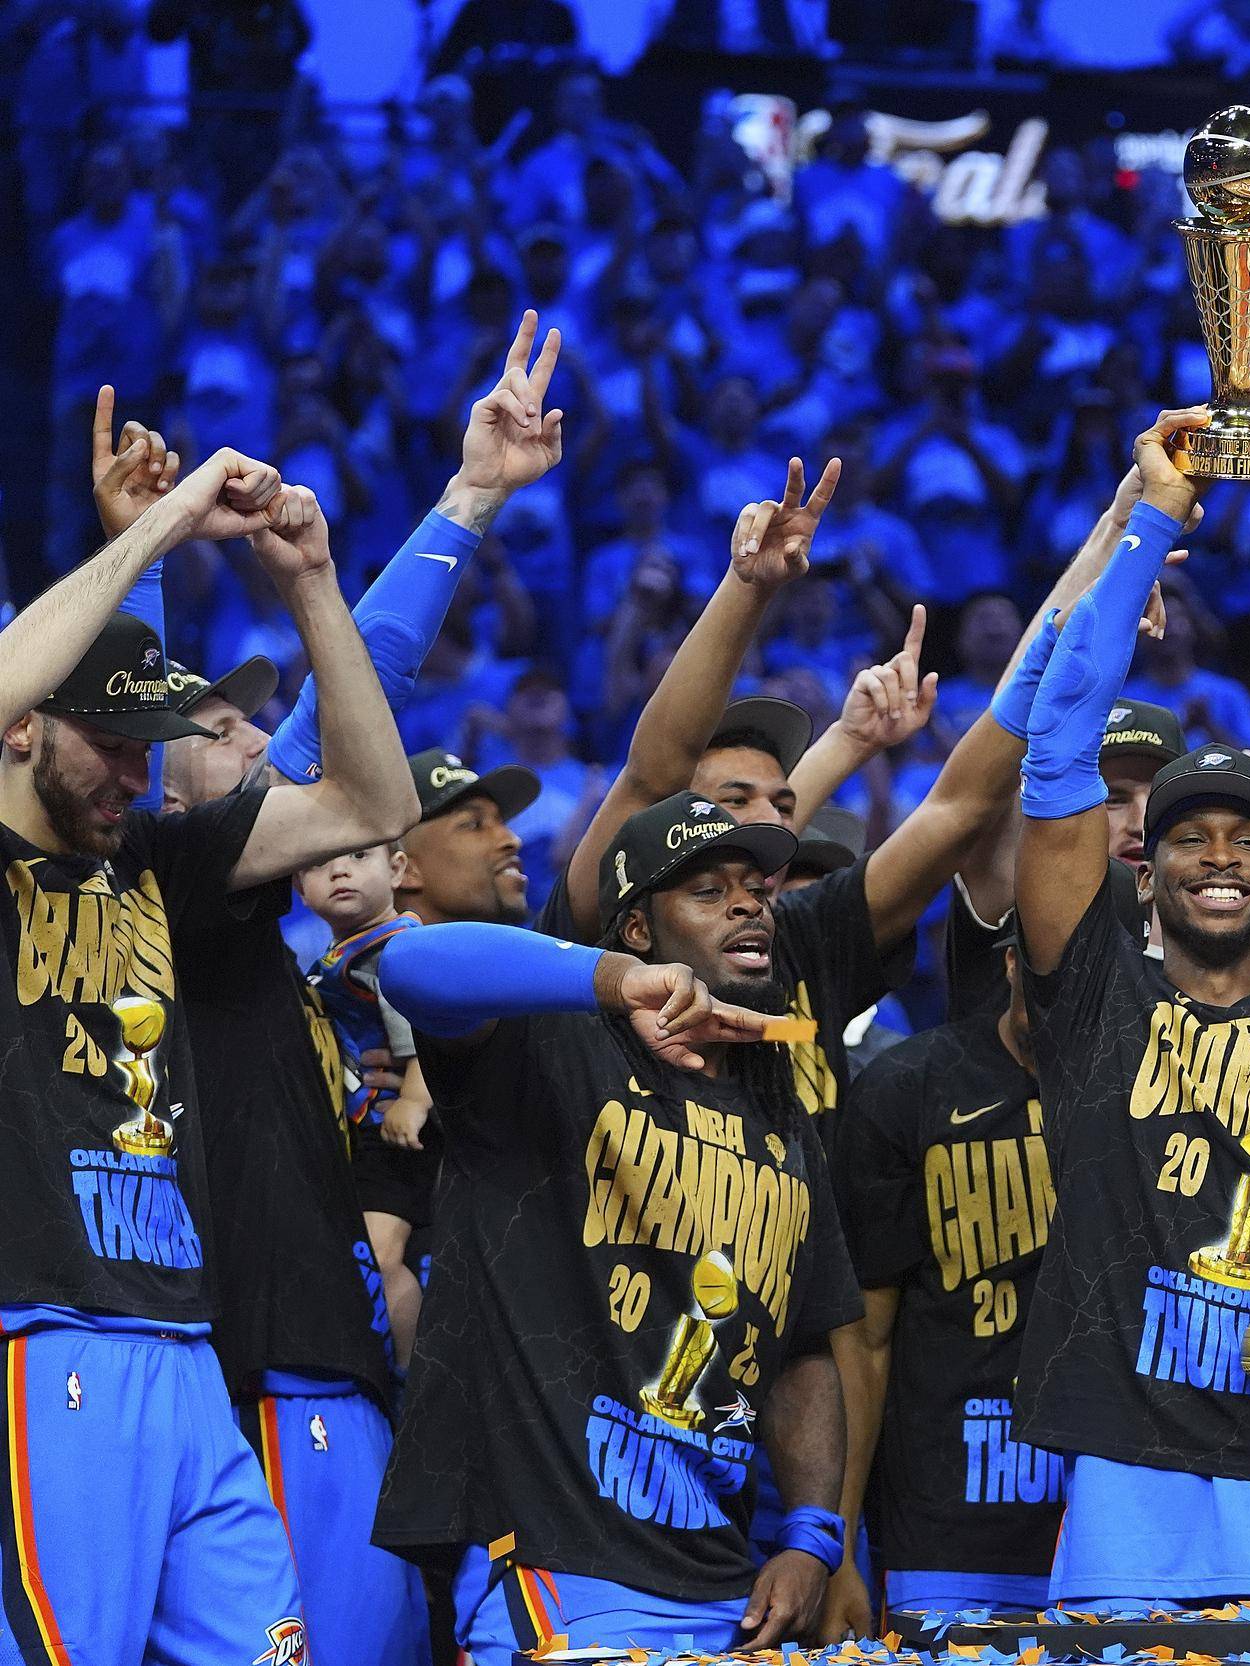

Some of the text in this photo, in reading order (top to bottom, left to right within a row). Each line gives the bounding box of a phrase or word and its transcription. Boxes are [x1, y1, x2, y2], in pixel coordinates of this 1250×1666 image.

[1214, 457, 1234, 473] NBA
[685, 1099, 746, 1155] NBA
[1156, 1132, 1211, 1197] 20
[609, 1263, 652, 1333] 20
[973, 1280, 1018, 1338] 20
[711, 1436, 755, 1461] CITY
